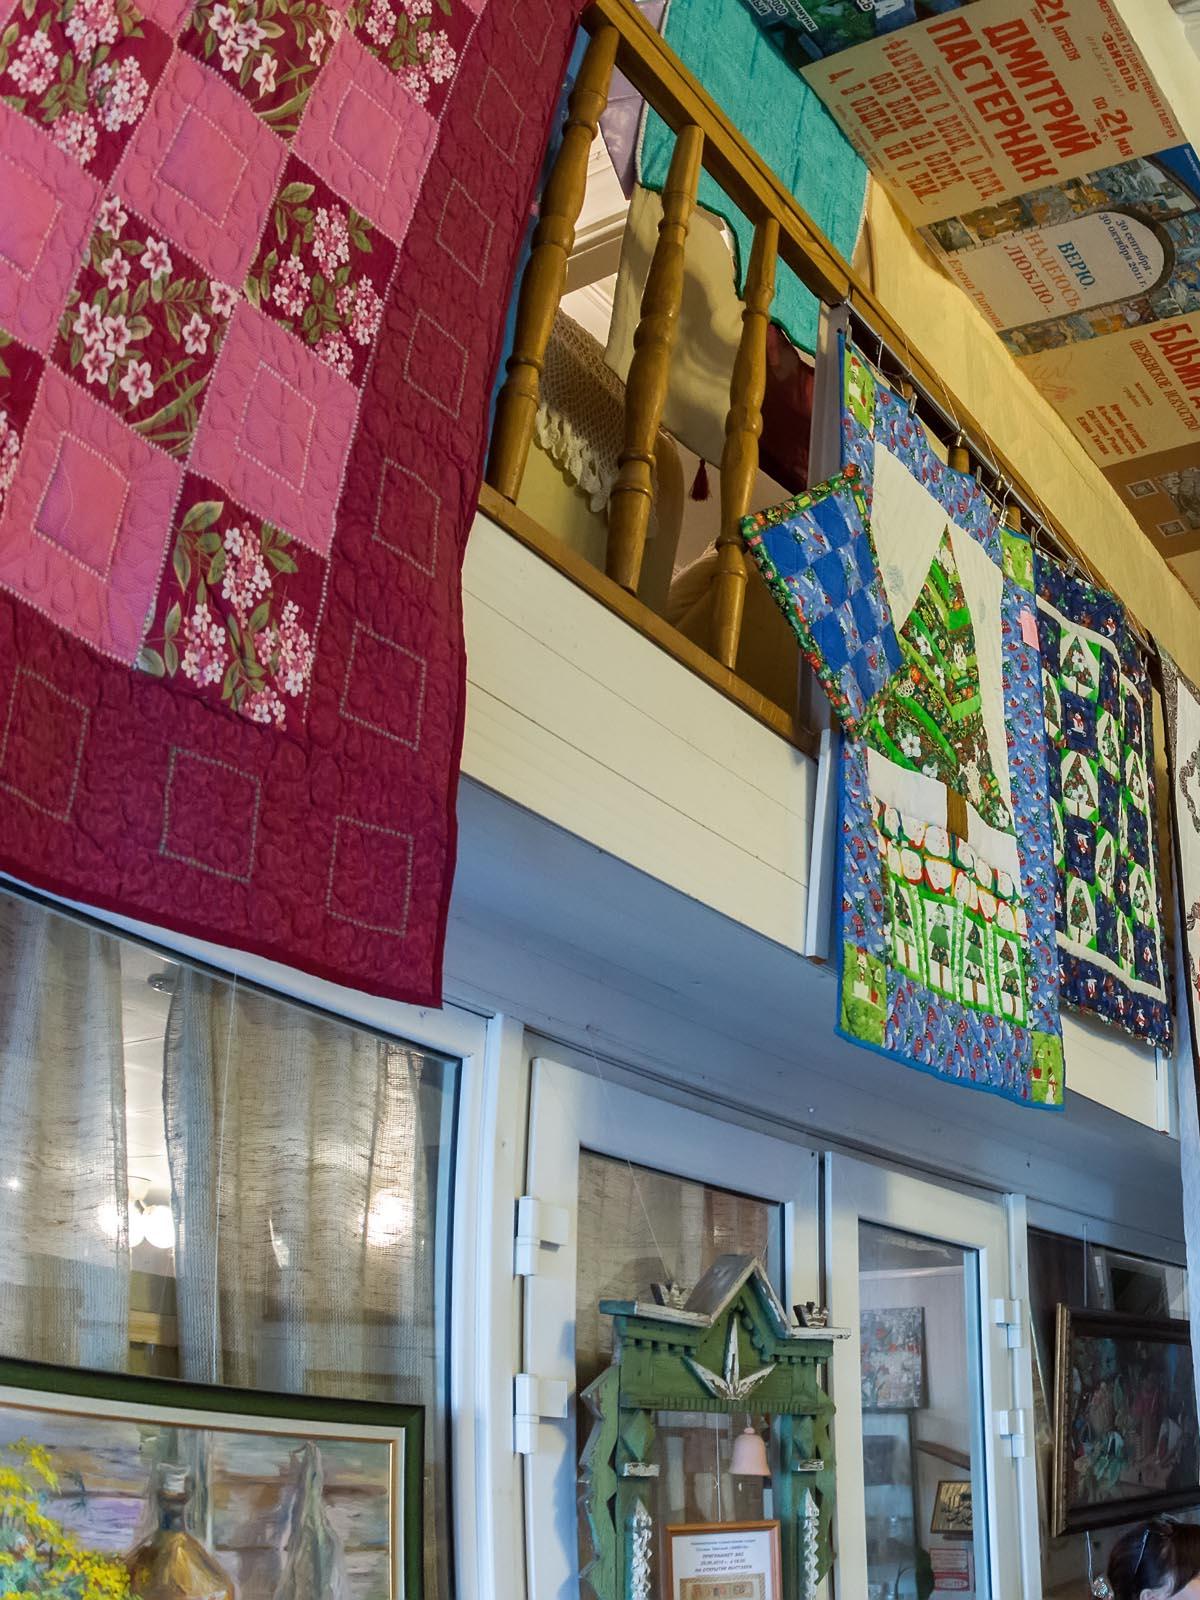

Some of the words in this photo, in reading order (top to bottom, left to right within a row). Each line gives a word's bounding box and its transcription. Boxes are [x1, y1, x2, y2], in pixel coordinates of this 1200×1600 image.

[1033, 0, 1072, 24] 21
[1051, 25, 1082, 62] АПРЕЛЯ
[868, 71, 902, 96] ОБО
[885, 95, 927, 131] ВСЕМ
[909, 130, 940, 150] НА
[926, 16, 1059, 183] ПАСТЕРНАК
[981, 18, 1102, 159] ДМИТРИЙ
[1092, 96, 1109, 111] ПО
[1122, 42, 1162, 108] ХУДОЖЕСТВЕННАЯ
[1156, 105, 1178, 140] ГАЛЕРЕЯ
[840, 82, 866, 96] В
[897, 161, 921, 172] О
[925, 102, 950, 114] О
[960, 155, 984, 166] О
[1100, 107, 1134, 137] 21
[1114, 136, 1135, 158] МАЯ
[1056, 240, 1096, 290] ВЕРЮ.
[1098, 213, 1110, 226] 30
[1107, 226, 1132, 264] октября
[1127, 262, 1142, 282] 2011
[1115, 219, 1127, 232] 30
[1123, 230, 1151, 272] сентября
[948, 254, 976, 291] Елена
